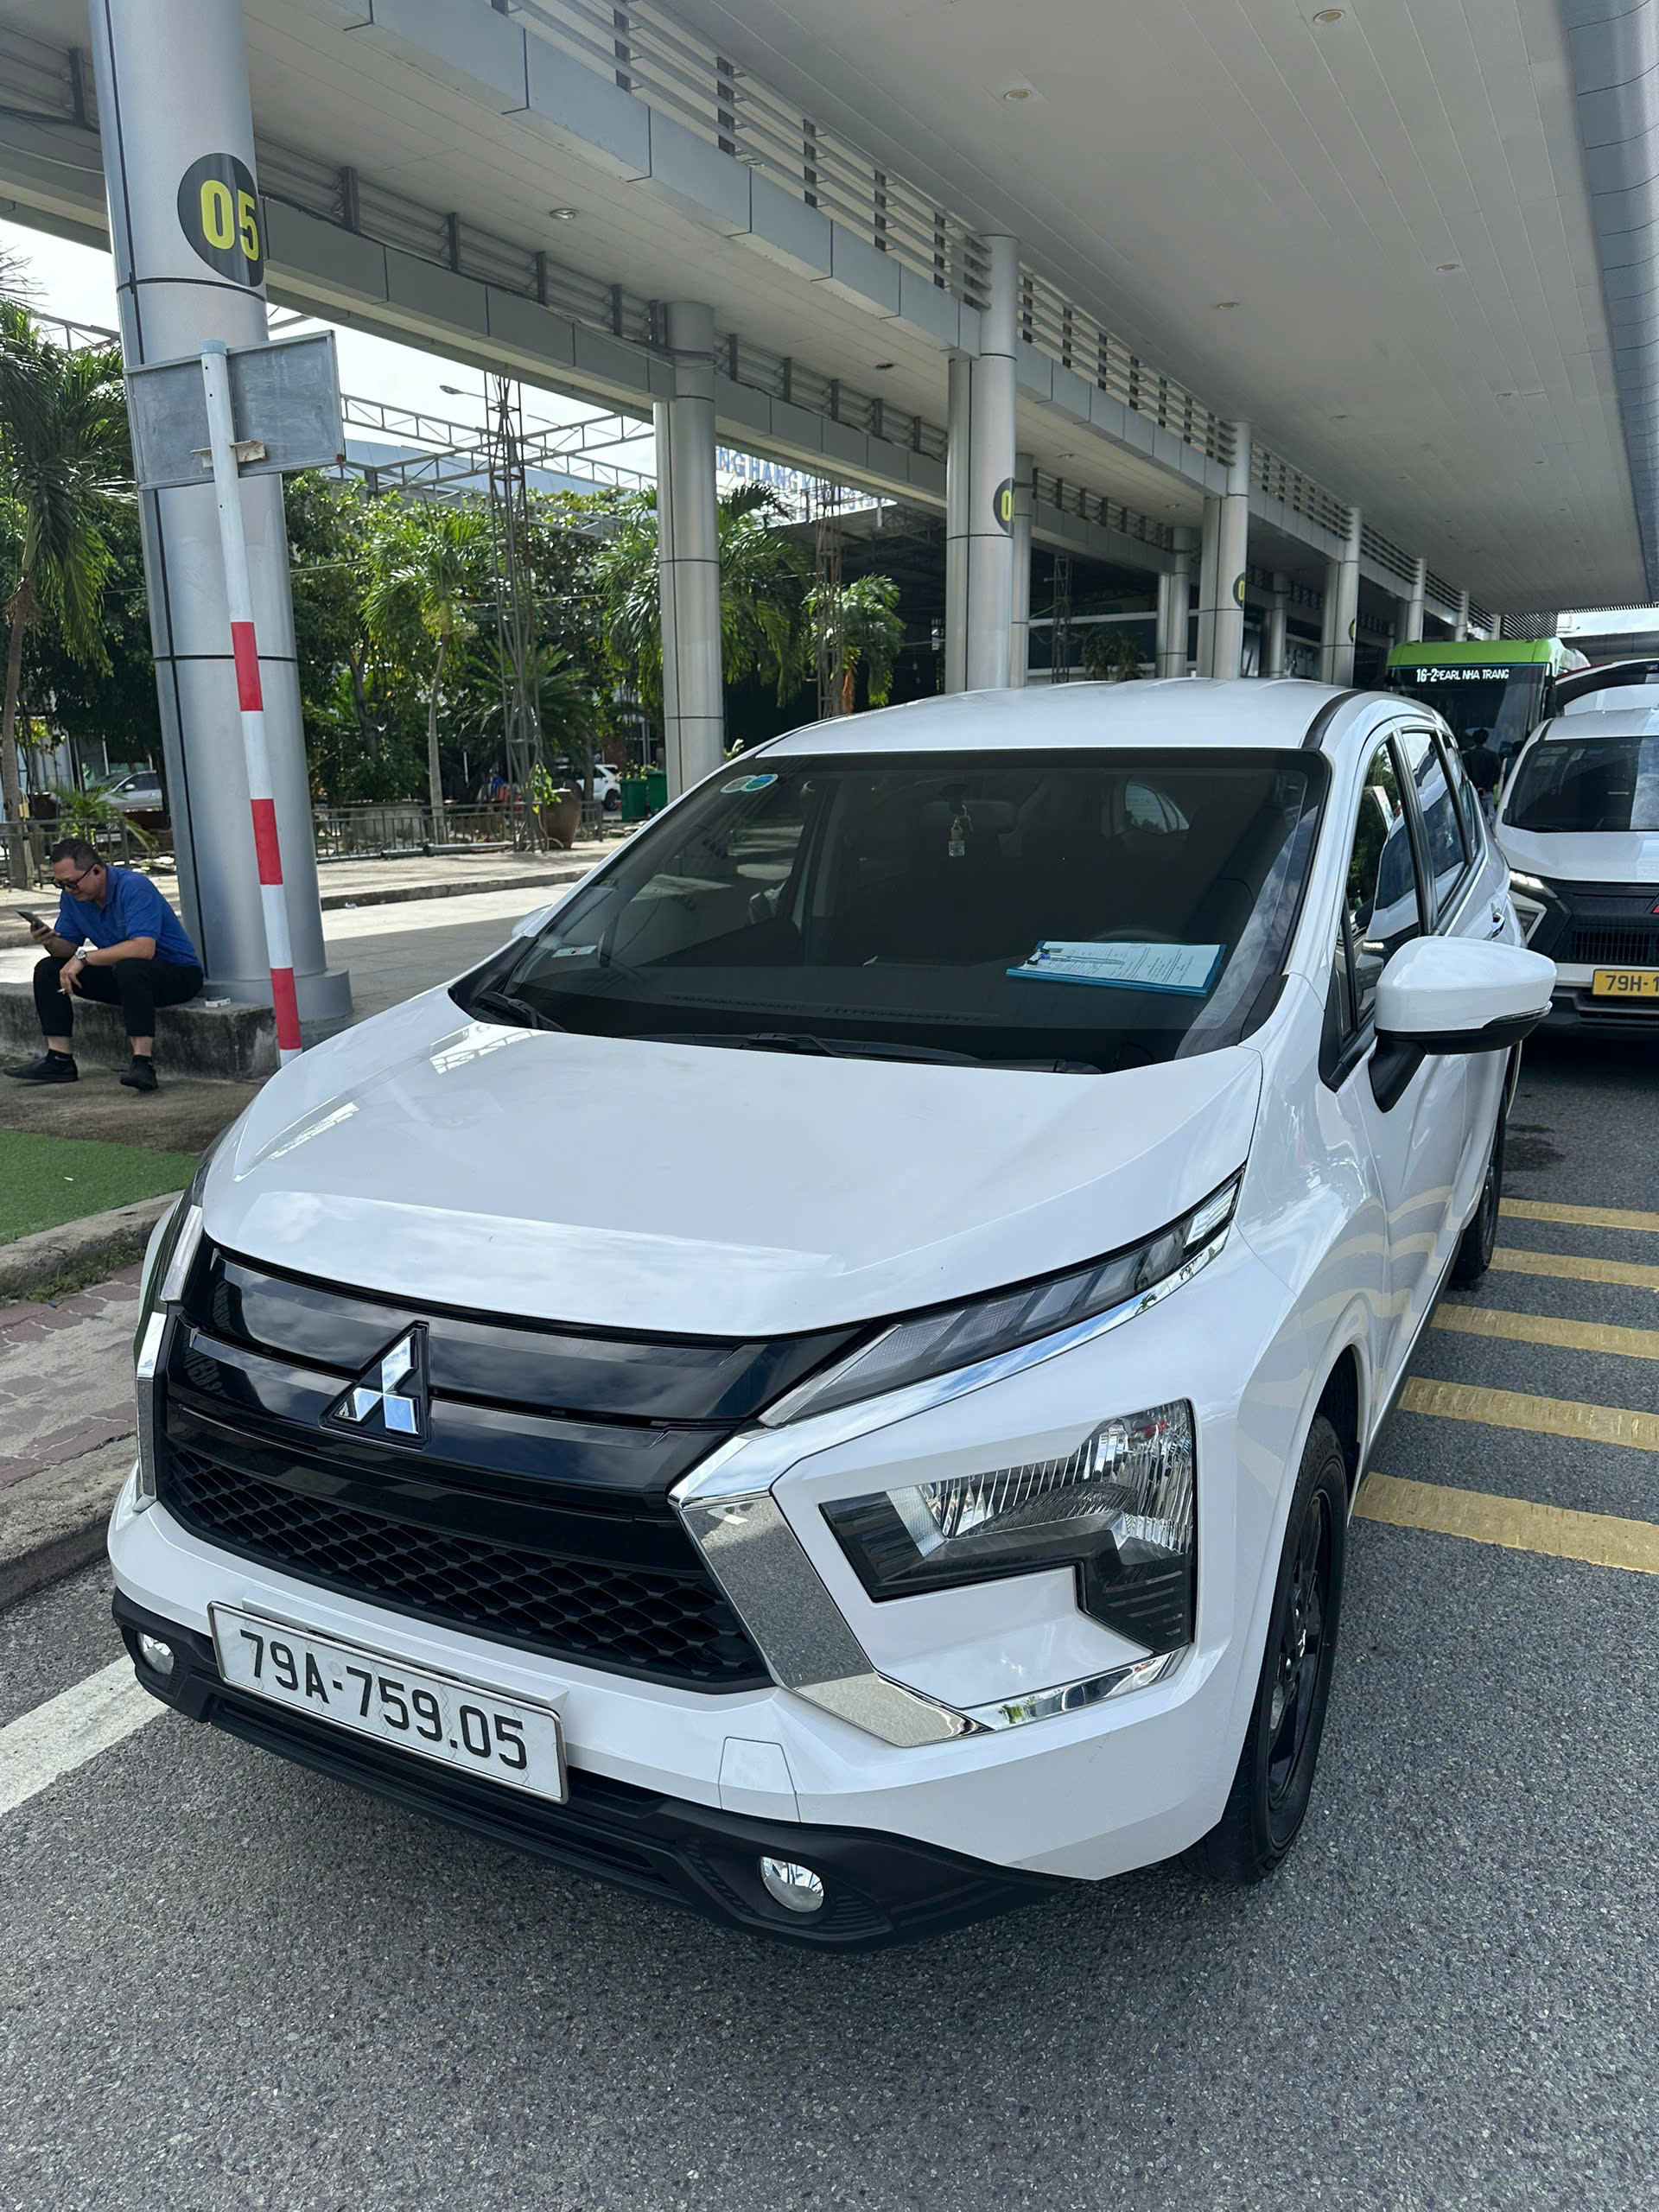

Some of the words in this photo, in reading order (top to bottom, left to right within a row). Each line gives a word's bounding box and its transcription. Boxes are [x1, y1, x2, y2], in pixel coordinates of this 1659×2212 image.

[200, 180, 258, 261] 05
[1001, 490, 1014, 522] 0
[1416, 668, 1437, 683] 16-2
[1462, 670, 1480, 680] NHA
[1482, 669, 1510, 679] TRANG
[240, 1630, 528, 1770] 79A-759.05
